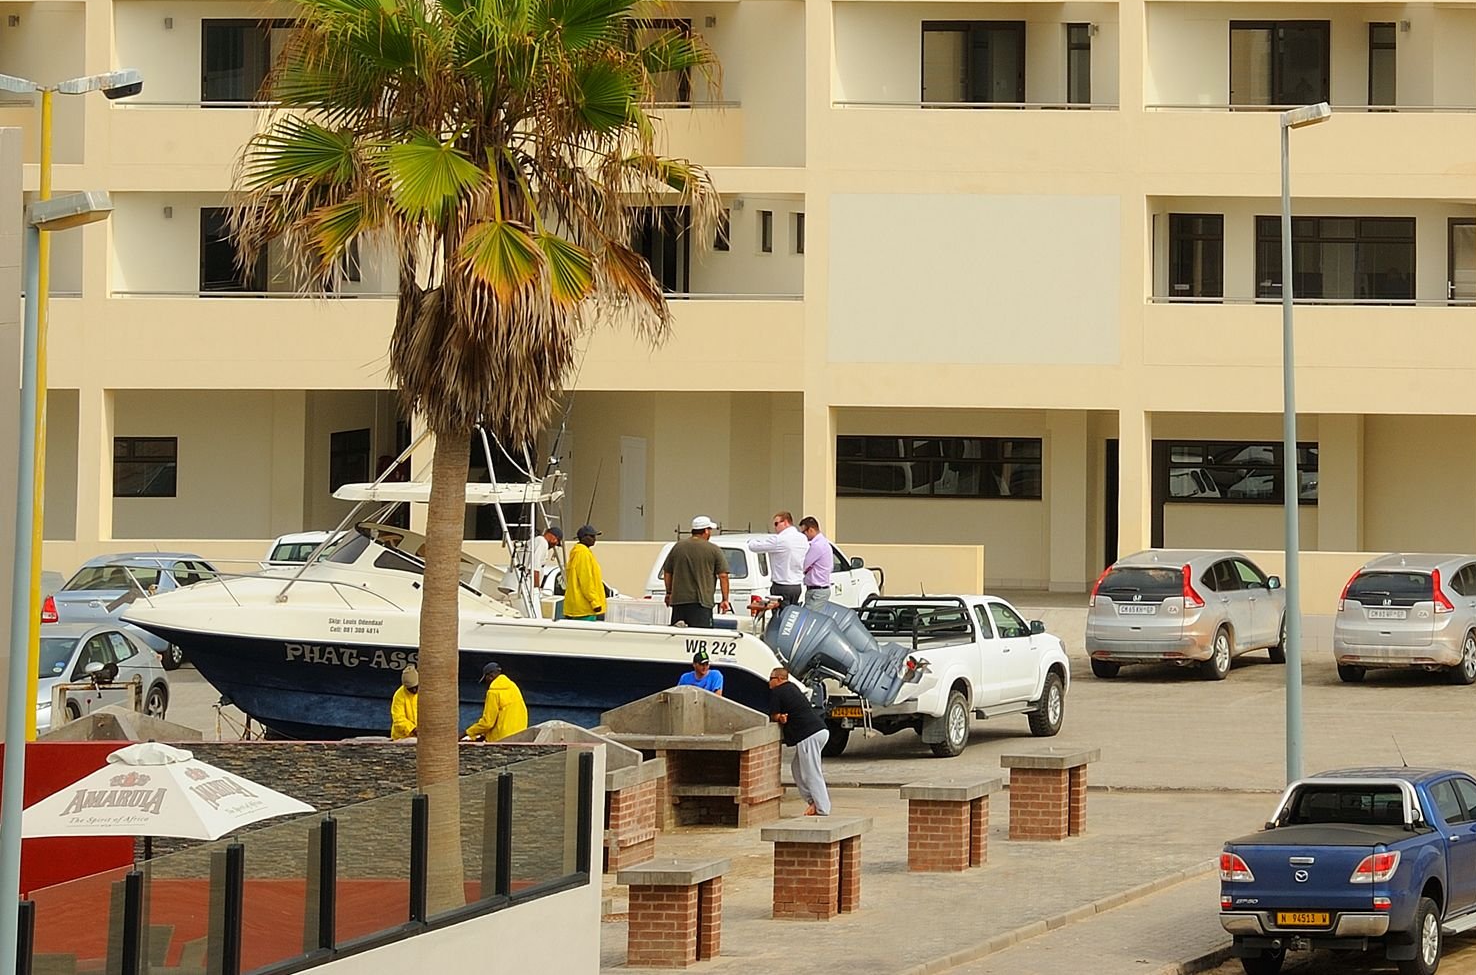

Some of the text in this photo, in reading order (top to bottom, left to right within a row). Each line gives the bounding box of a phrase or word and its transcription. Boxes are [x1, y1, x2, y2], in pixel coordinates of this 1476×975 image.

[781, 610, 799, 637] YAMAHA
[711, 640, 737, 656] 242
[59, 787, 168, 817] AMARULA
[86, 816, 111, 824] Spirit
[1281, 913, 1327, 923] N 94513 W
